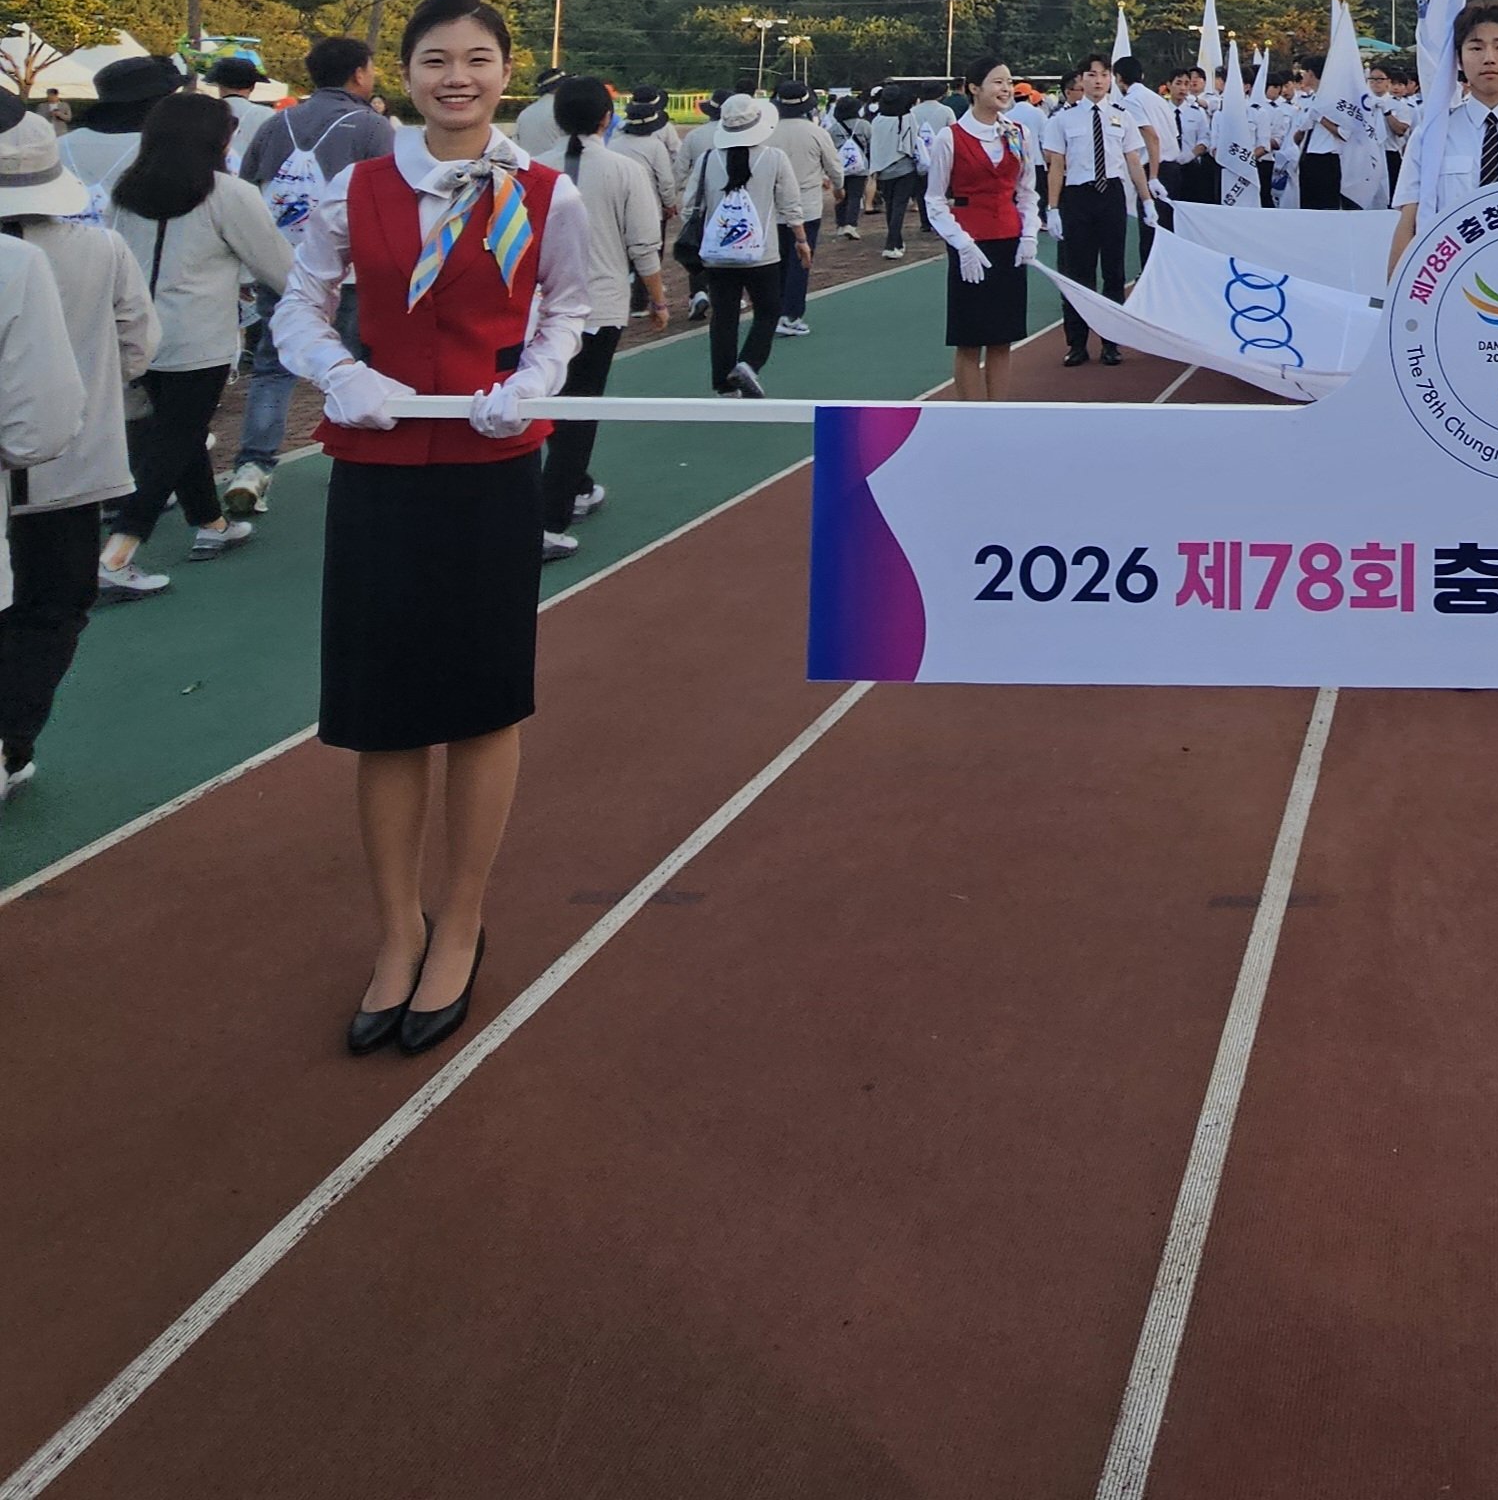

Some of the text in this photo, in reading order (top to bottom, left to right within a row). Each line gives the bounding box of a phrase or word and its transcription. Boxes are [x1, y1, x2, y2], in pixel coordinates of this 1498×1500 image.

[1409, 235, 1462, 305] 제78회
[1406, 344, 1426, 378] The
[1416, 378, 1447, 419] 78th
[973, 543, 1159, 604] 2026
[1174, 540, 1416, 613] 제78회
